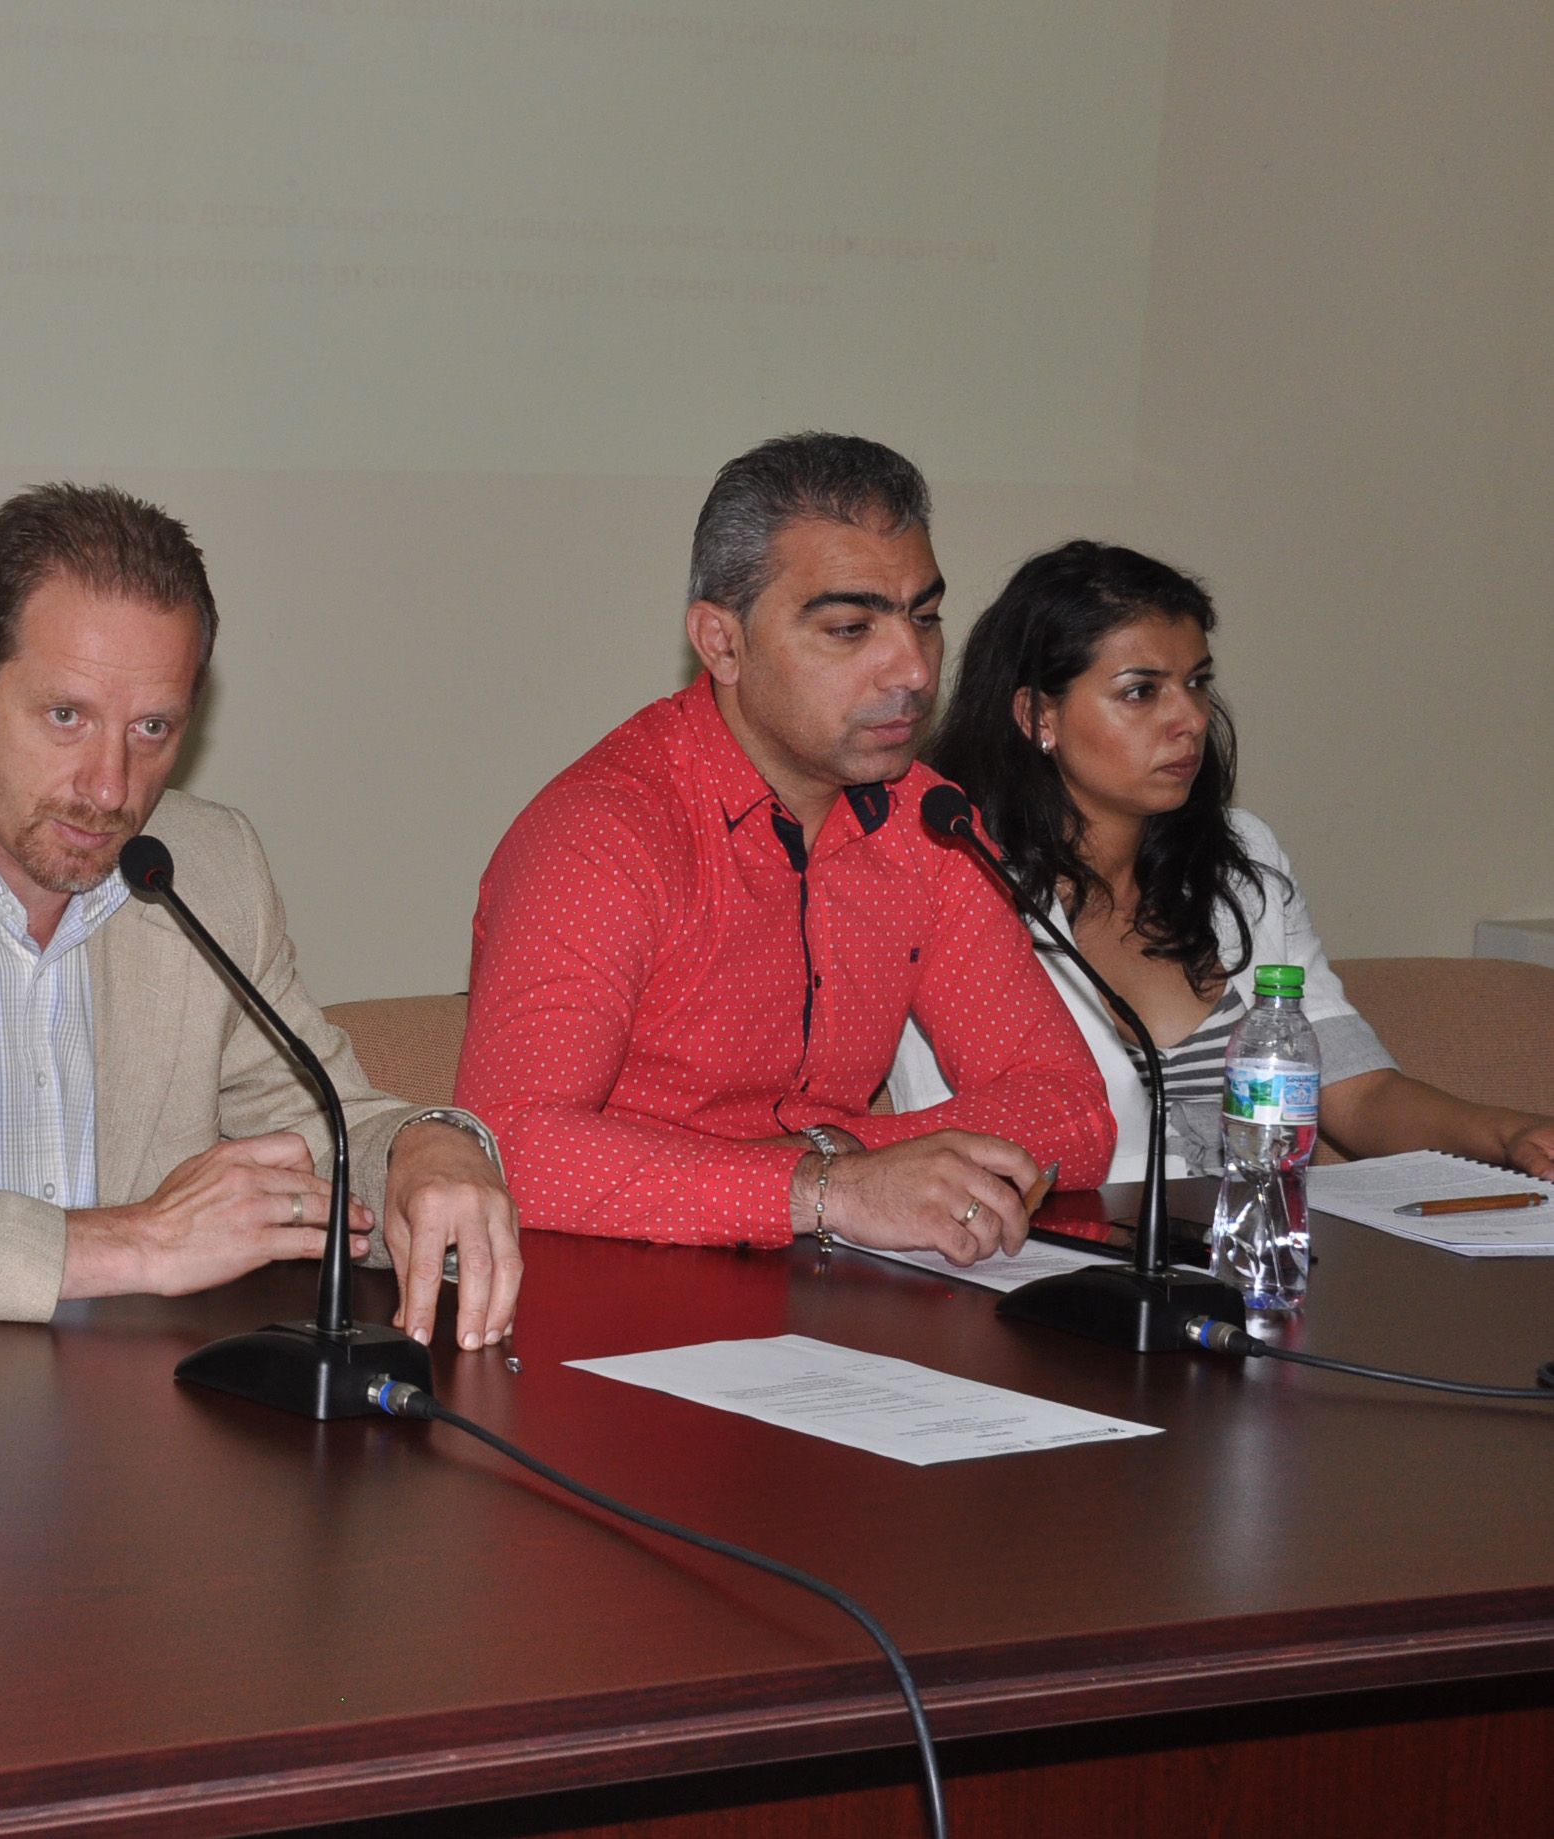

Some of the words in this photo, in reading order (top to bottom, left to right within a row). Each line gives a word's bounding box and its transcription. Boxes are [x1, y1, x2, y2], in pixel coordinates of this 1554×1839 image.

[182, 35, 215, 58] от
[79, 196, 188, 225] висока
[197, 202, 299, 232] детска
[499, 269, 598, 300] трудов
[633, 276, 735, 301] семеен
